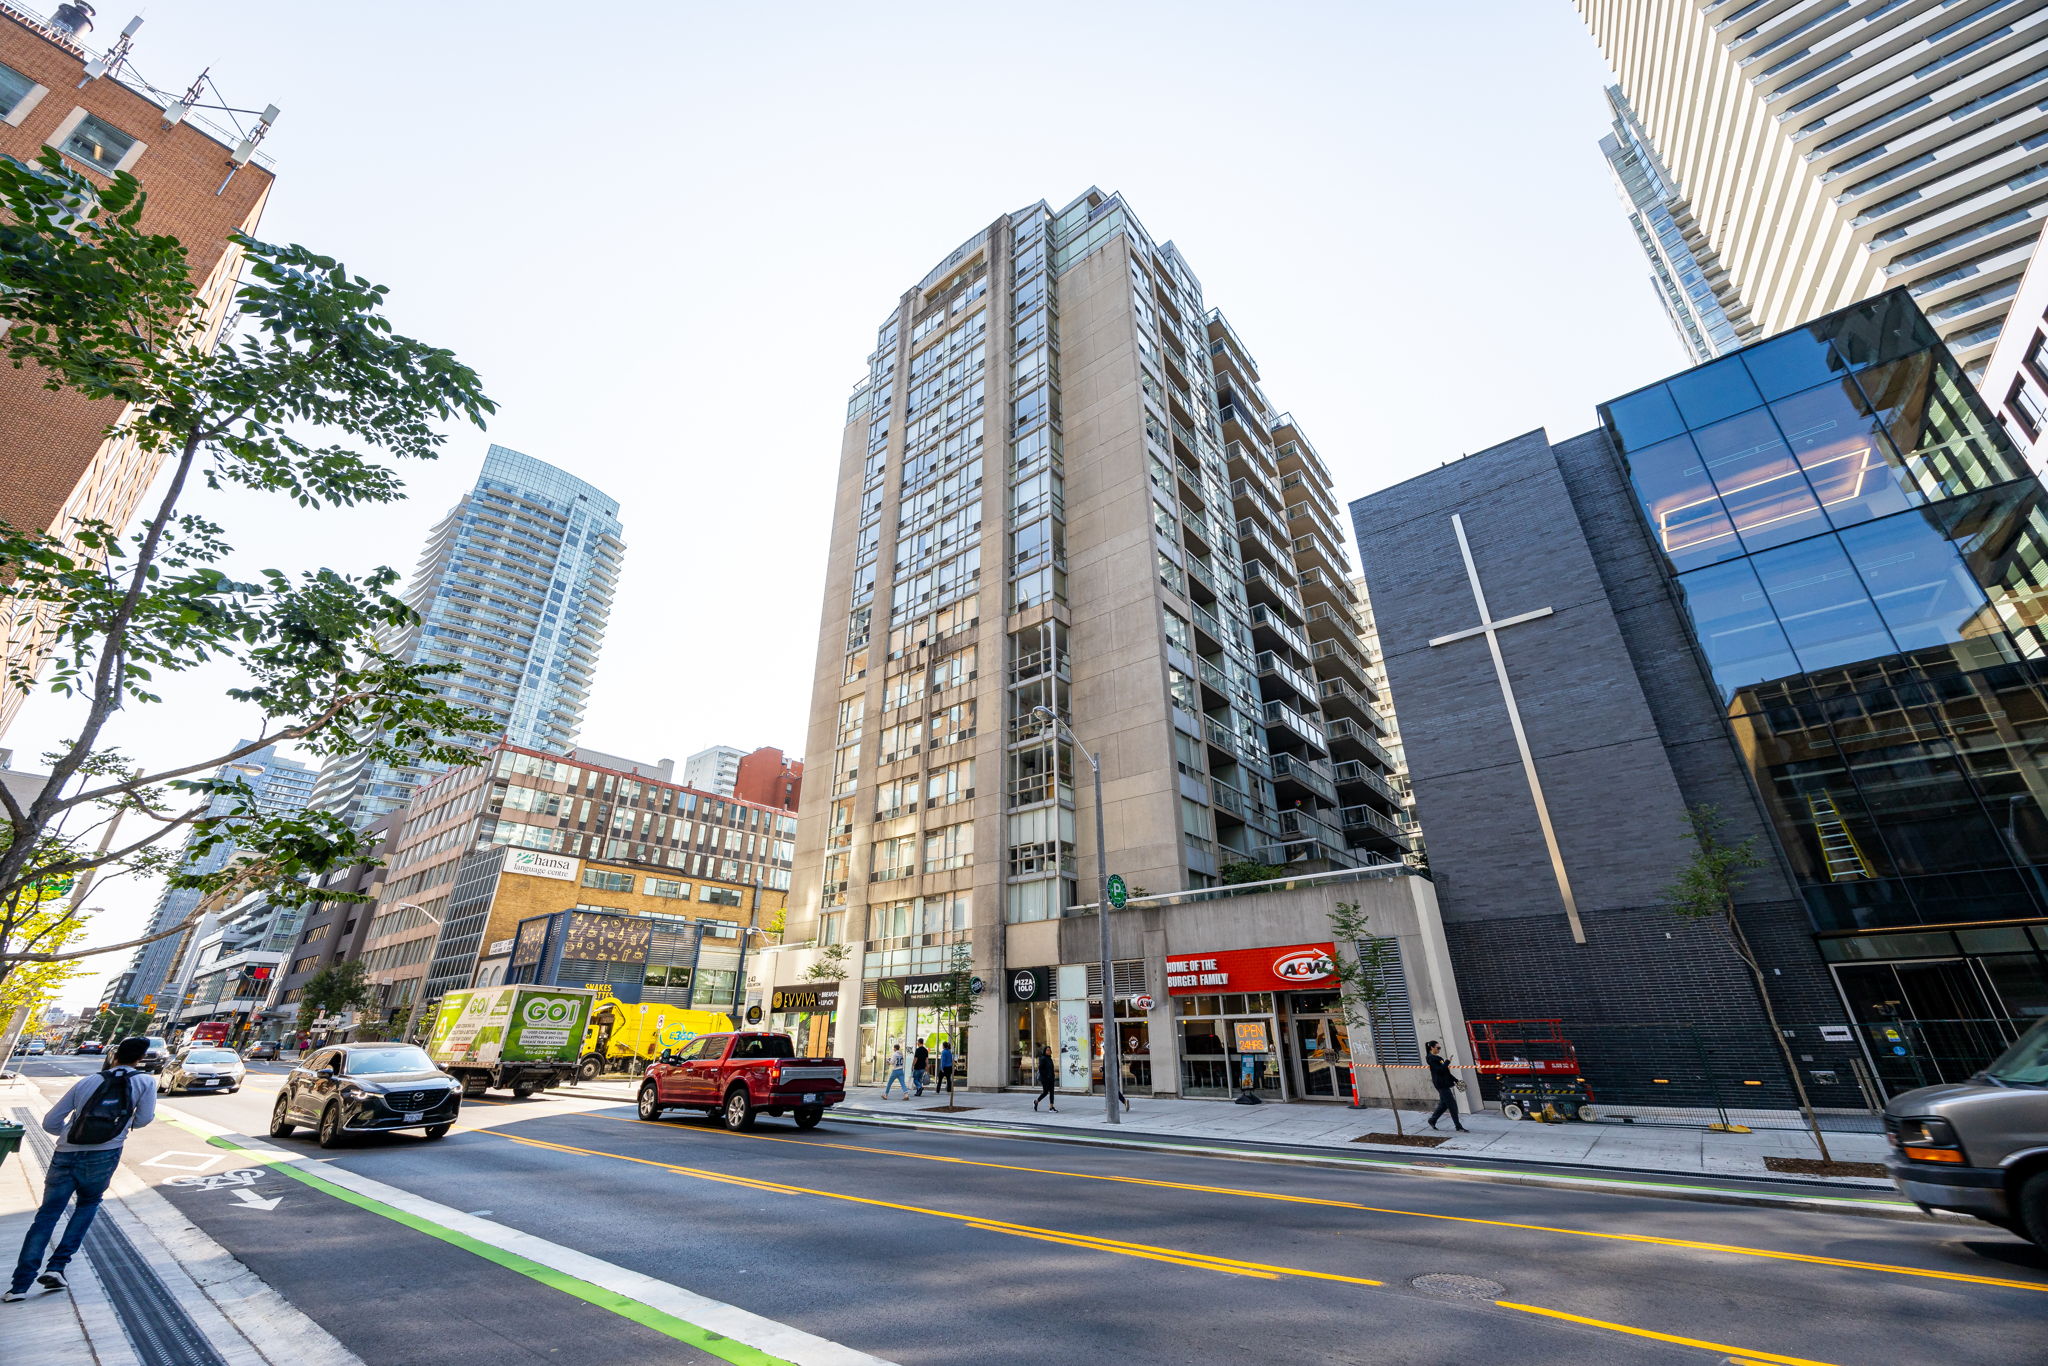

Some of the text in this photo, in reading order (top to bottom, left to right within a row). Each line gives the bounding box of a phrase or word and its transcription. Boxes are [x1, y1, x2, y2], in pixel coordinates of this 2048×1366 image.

[534, 854, 570, 870] hansa
[513, 863, 569, 878] language centre
[1113, 882, 1121, 896] P
[1167, 959, 1217, 973] HOME OF THE
[1283, 962, 1326, 976] A&W
[585, 983, 612, 991] SNAKES
[1167, 973, 1229, 987] BURGER FAMILY
[784, 992, 816, 1008] EVVIVA
[1236, 1023, 1264, 1038] OPEN
[1239, 1039, 1264, 1051] 24HRS
